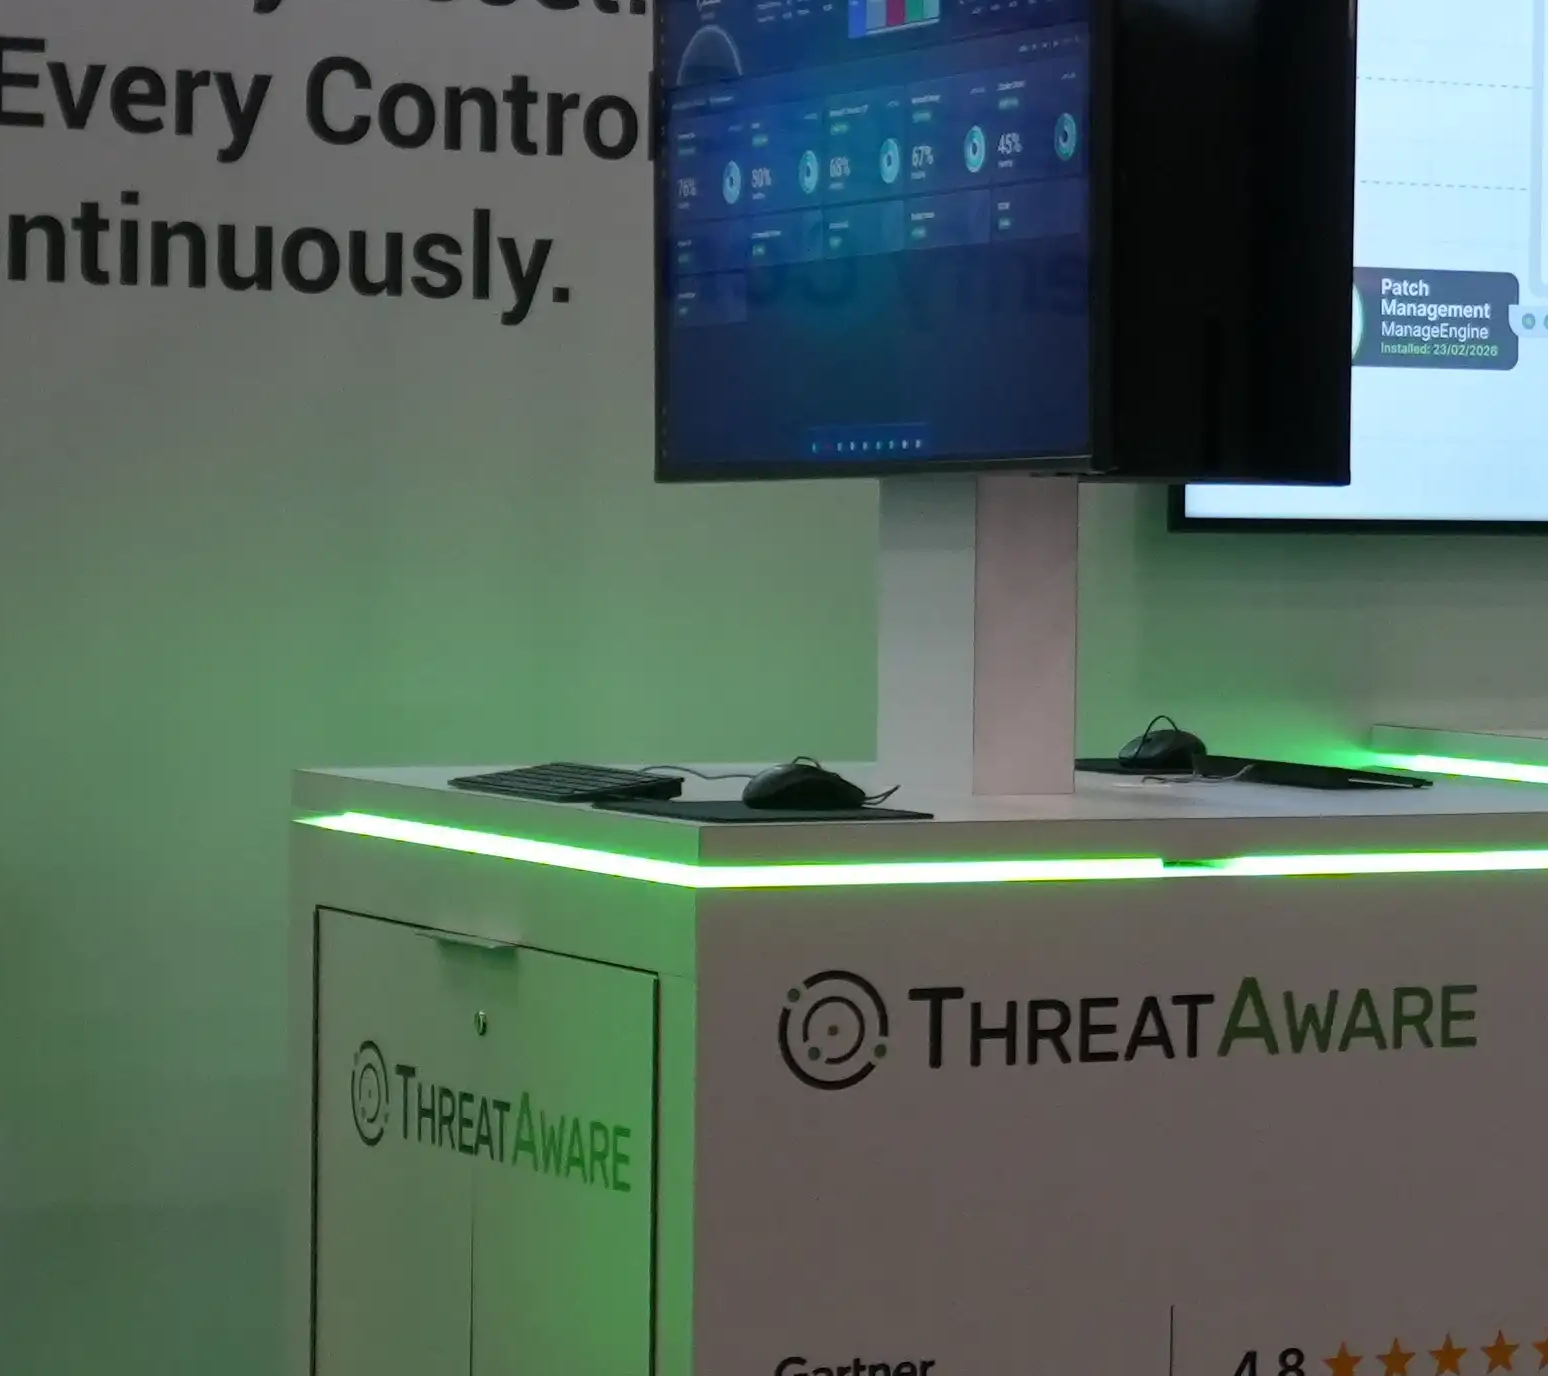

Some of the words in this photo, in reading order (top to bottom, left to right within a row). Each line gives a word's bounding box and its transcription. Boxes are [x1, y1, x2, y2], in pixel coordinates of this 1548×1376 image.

[1381, 278, 1429, 297] Patch
[1380, 299, 1490, 320] Management
[1380, 321, 1489, 341] ManageEngine
[1380, 342, 1431, 356] Installed:
[906, 975, 1479, 1071] THREATAWARE
[395, 1063, 632, 1193] THREATAWARE
